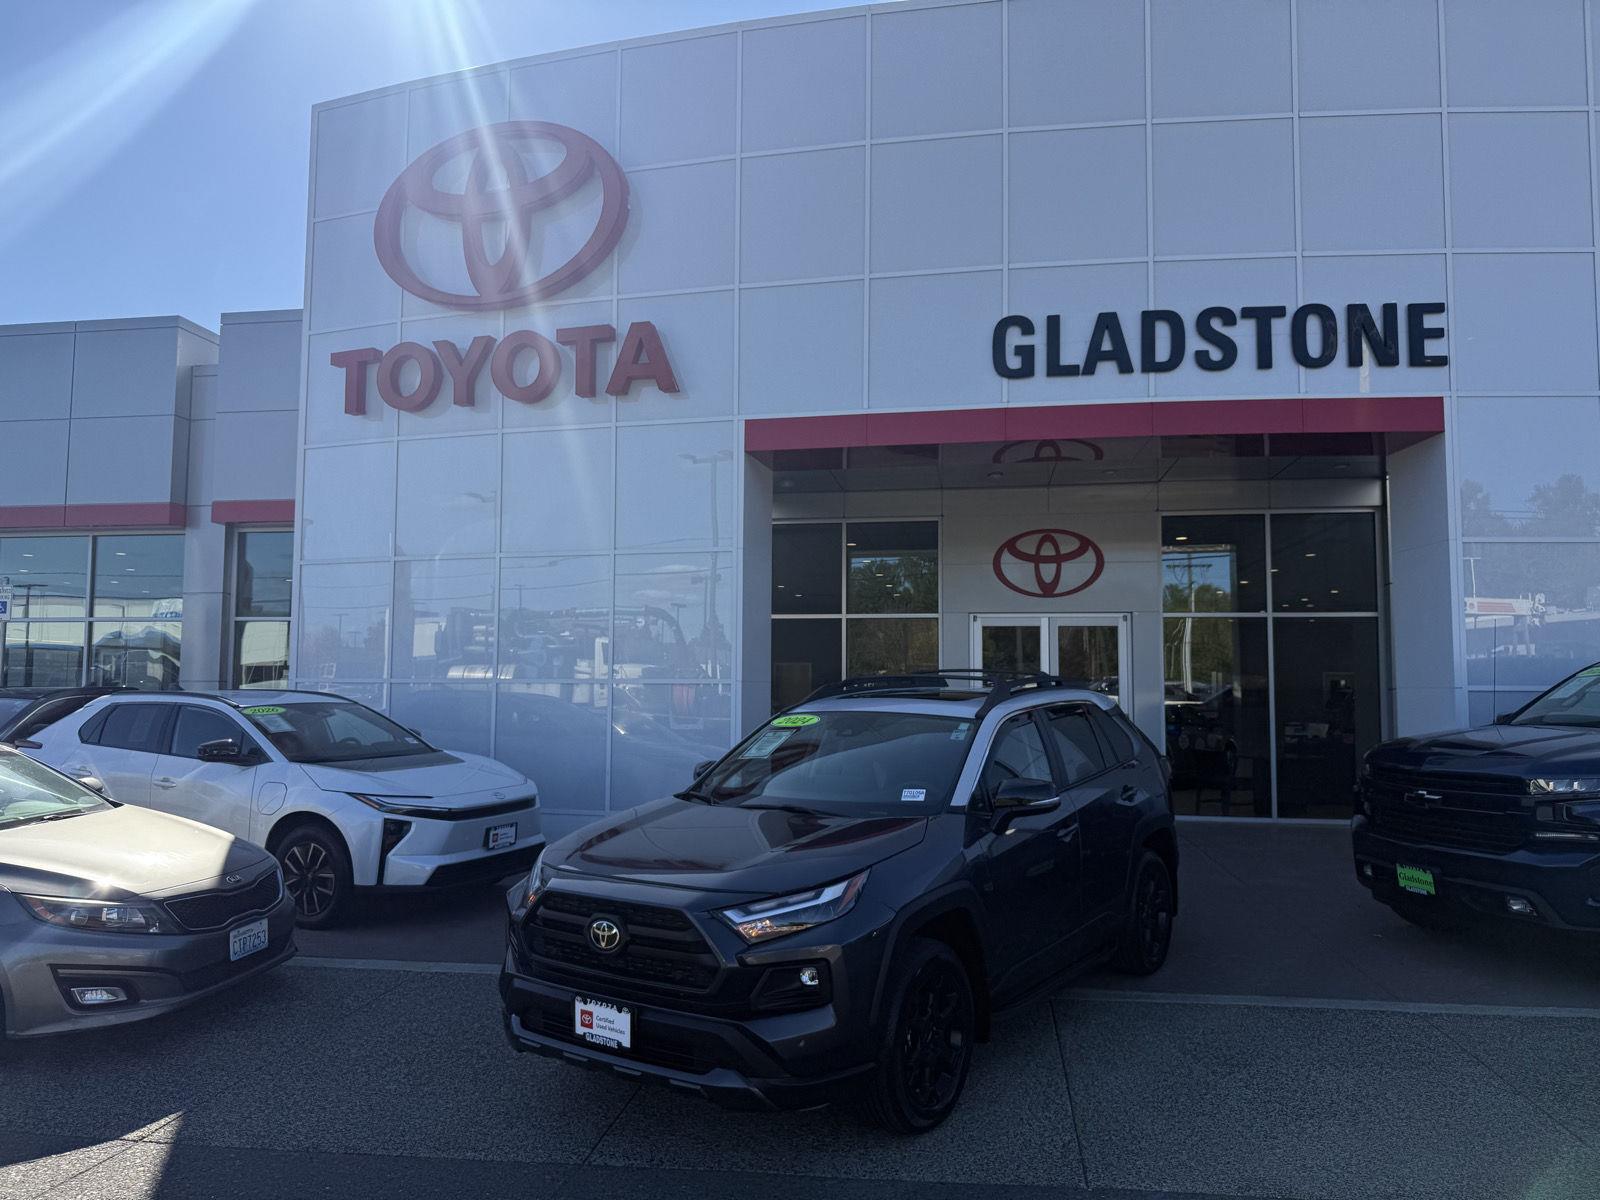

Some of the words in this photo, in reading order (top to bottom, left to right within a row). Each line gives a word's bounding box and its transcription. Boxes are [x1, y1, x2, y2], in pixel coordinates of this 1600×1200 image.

[992, 302, 1448, 380] GLADSTONE
[330, 321, 681, 416] TOYOTA
[586, 998, 618, 1011] TOYOTA
[596, 1015, 615, 1025] Certified
[596, 1023, 608, 1031] Used
[608, 1026, 626, 1036] Vehicles
[585, 1033, 619, 1049] GLADSTONE
